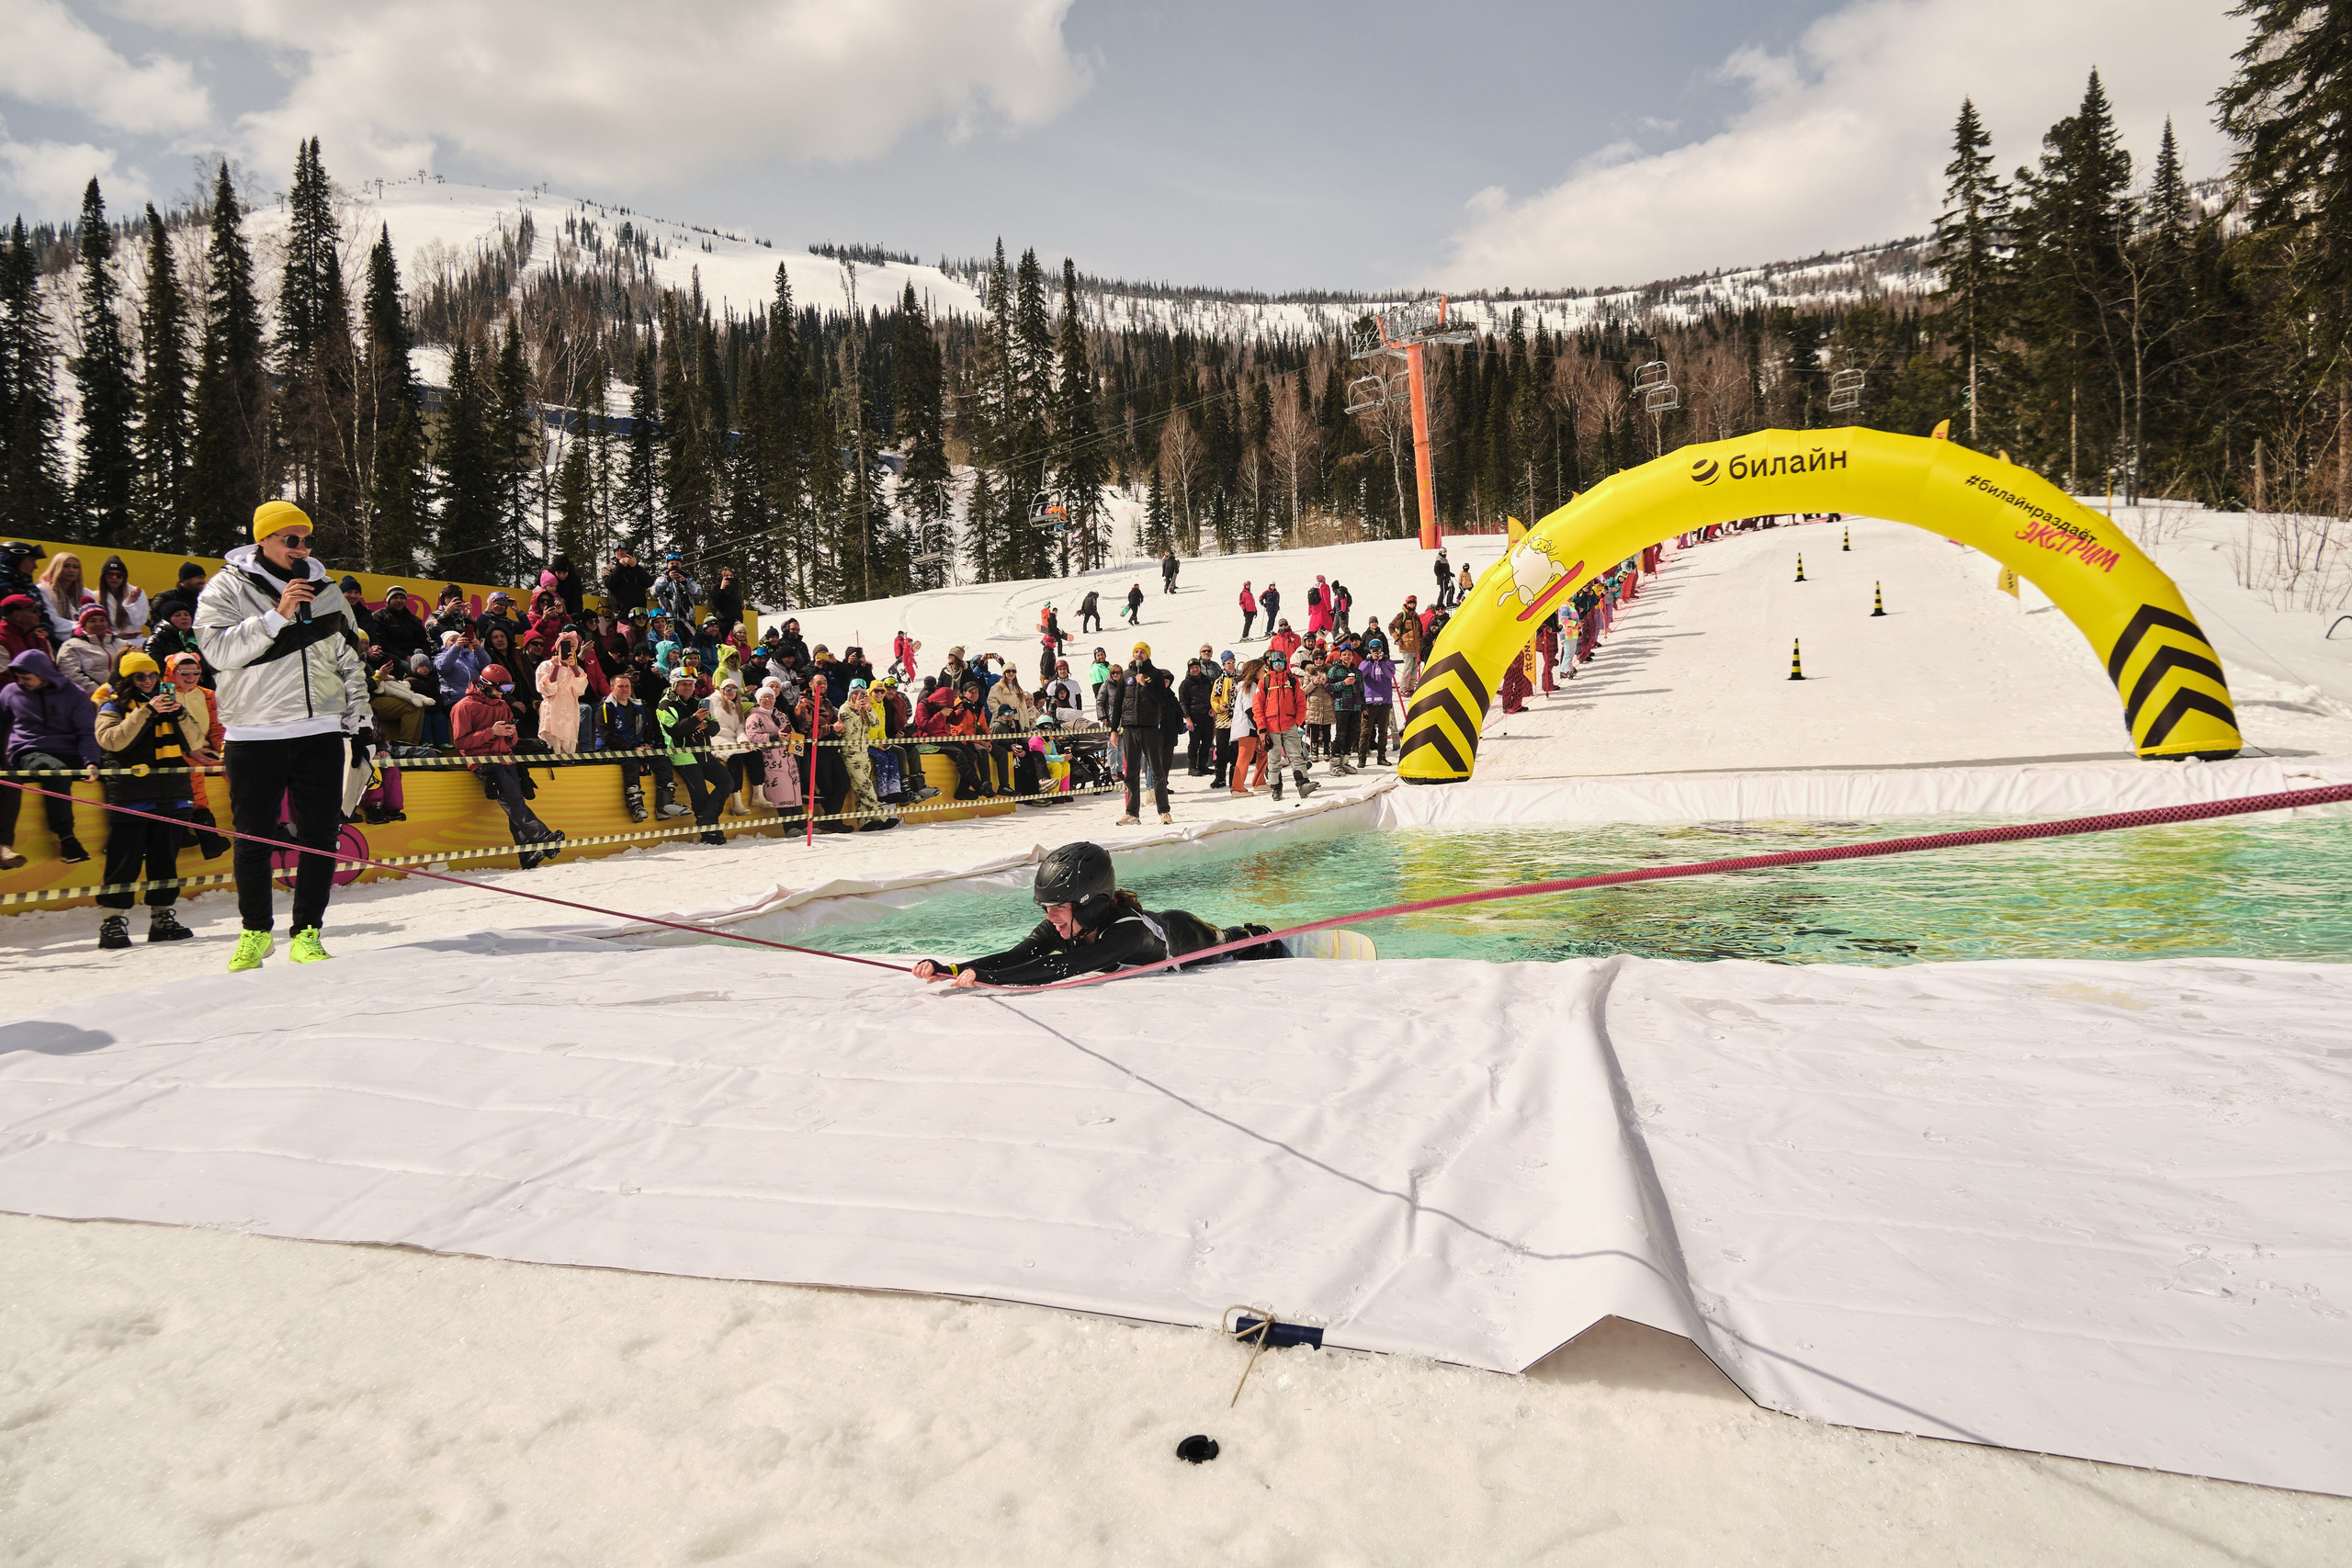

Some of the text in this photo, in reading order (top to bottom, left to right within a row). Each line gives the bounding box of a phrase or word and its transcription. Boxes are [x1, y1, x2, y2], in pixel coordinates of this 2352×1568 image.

[1729, 446, 1847, 480] билайн
[1964, 474, 2098, 544] #билайнраздаёт
[2015, 521, 2121, 573] ЭКСТРИМ
